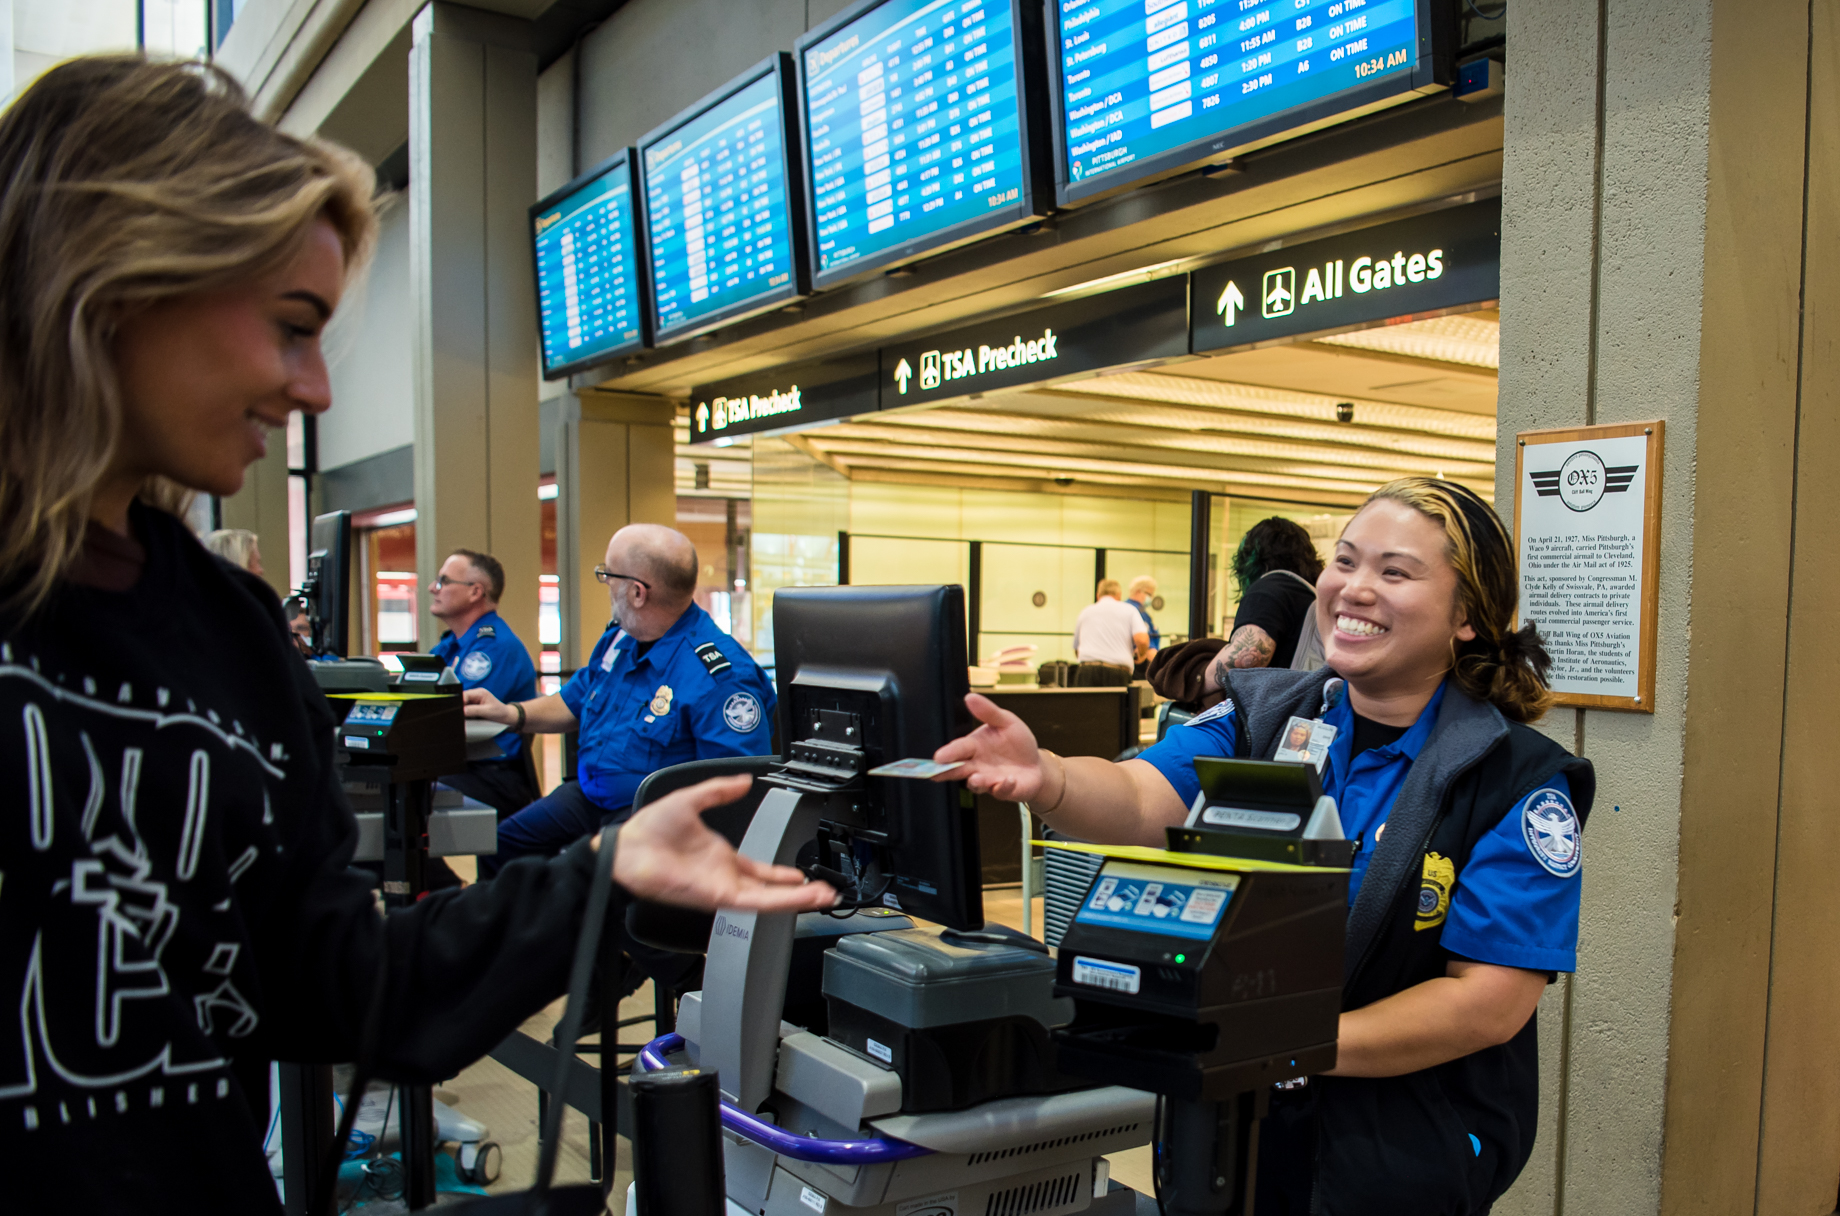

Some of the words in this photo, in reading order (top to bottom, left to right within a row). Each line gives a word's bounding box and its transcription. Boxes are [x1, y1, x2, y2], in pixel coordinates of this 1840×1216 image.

[1328, 2, 1343, 17] ON
[1344, 0, 1366, 11] TIME
[1064, 7, 1100, 31] Philadelphia
[1239, 17, 1255, 31] 4:00
[1256, 10, 1269, 25] PM
[1296, 15, 1312, 31] B28
[1329, 24, 1344, 39] ON
[1345, 15, 1367, 33] TIME
[1073, 31, 1090, 45] Louis
[1262, 29, 1276, 44] AM
[1297, 37, 1313, 52] B28
[1330, 46, 1344, 61] ON
[1346, 38, 1368, 56] TIME
[1242, 58, 1257, 73] 1:20
[1258, 52, 1271, 67] PM
[1298, 60, 1309, 74] A6
[1354, 56, 1384, 78] 10:34
[1387, 48, 1407, 68] AM
[1067, 70, 1090, 84] Toronto
[1259, 73, 1272, 88] PM
[1068, 87, 1091, 103] Toronto
[1069, 101, 1104, 121] Washington
[1108, 92, 1122, 105] DCA
[1070, 119, 1105, 139] Washington
[1109, 110, 1124, 124] DCA
[1071, 138, 1106, 157] Washington
[1092, 146, 1127, 165] PITTSBURGH
[1300, 259, 1343, 305] All
[1349, 249, 1443, 294] Gates
[942, 348, 976, 381] TSA
[978, 328, 1058, 374] Precheck
[727, 397, 751, 424] TSA
[750, 384, 801, 420] Precheck
[1567, 469, 1597, 486] OX5
[1538, 536, 1552, 544] April
[1597, 534, 1630, 542] Pittsburgh,
[1598, 543, 1634, 551] Pittsburgh's
[1604, 552, 1635, 560] Cleveland,
[1549, 575, 1576, 583] sponsored
[1578, 575, 1585, 583] by
[1587, 575, 1626, 583] Congressman
[1525, 583, 1541, 591] Clyde
[1550, 592, 1572, 600] delivery
[1609, 592, 1630, 600] private
[1606, 601, 1629, 609] delivery
[1584, 609, 1613, 617] America's
[1615, 609, 1627, 617] first
[1566, 631, 1580, 639] Wing
[1606, 632, 1630, 640] Aviation
[1566, 648, 1586, 656] Horan,
[1599, 649, 1623, 657] students
[1590, 641, 1625, 649] Pittsburgh's
[702, 650, 723, 663] TSA
[1558, 656, 1580, 664] Institute
[1590, 658, 1627, 667] Aeronautics,
[1605, 667, 1635, 675] volunteers
[1567, 674, 1598, 682] restoration
[1600, 675, 1625, 684] possible.
[726, 924, 749, 941] IDEMIA
